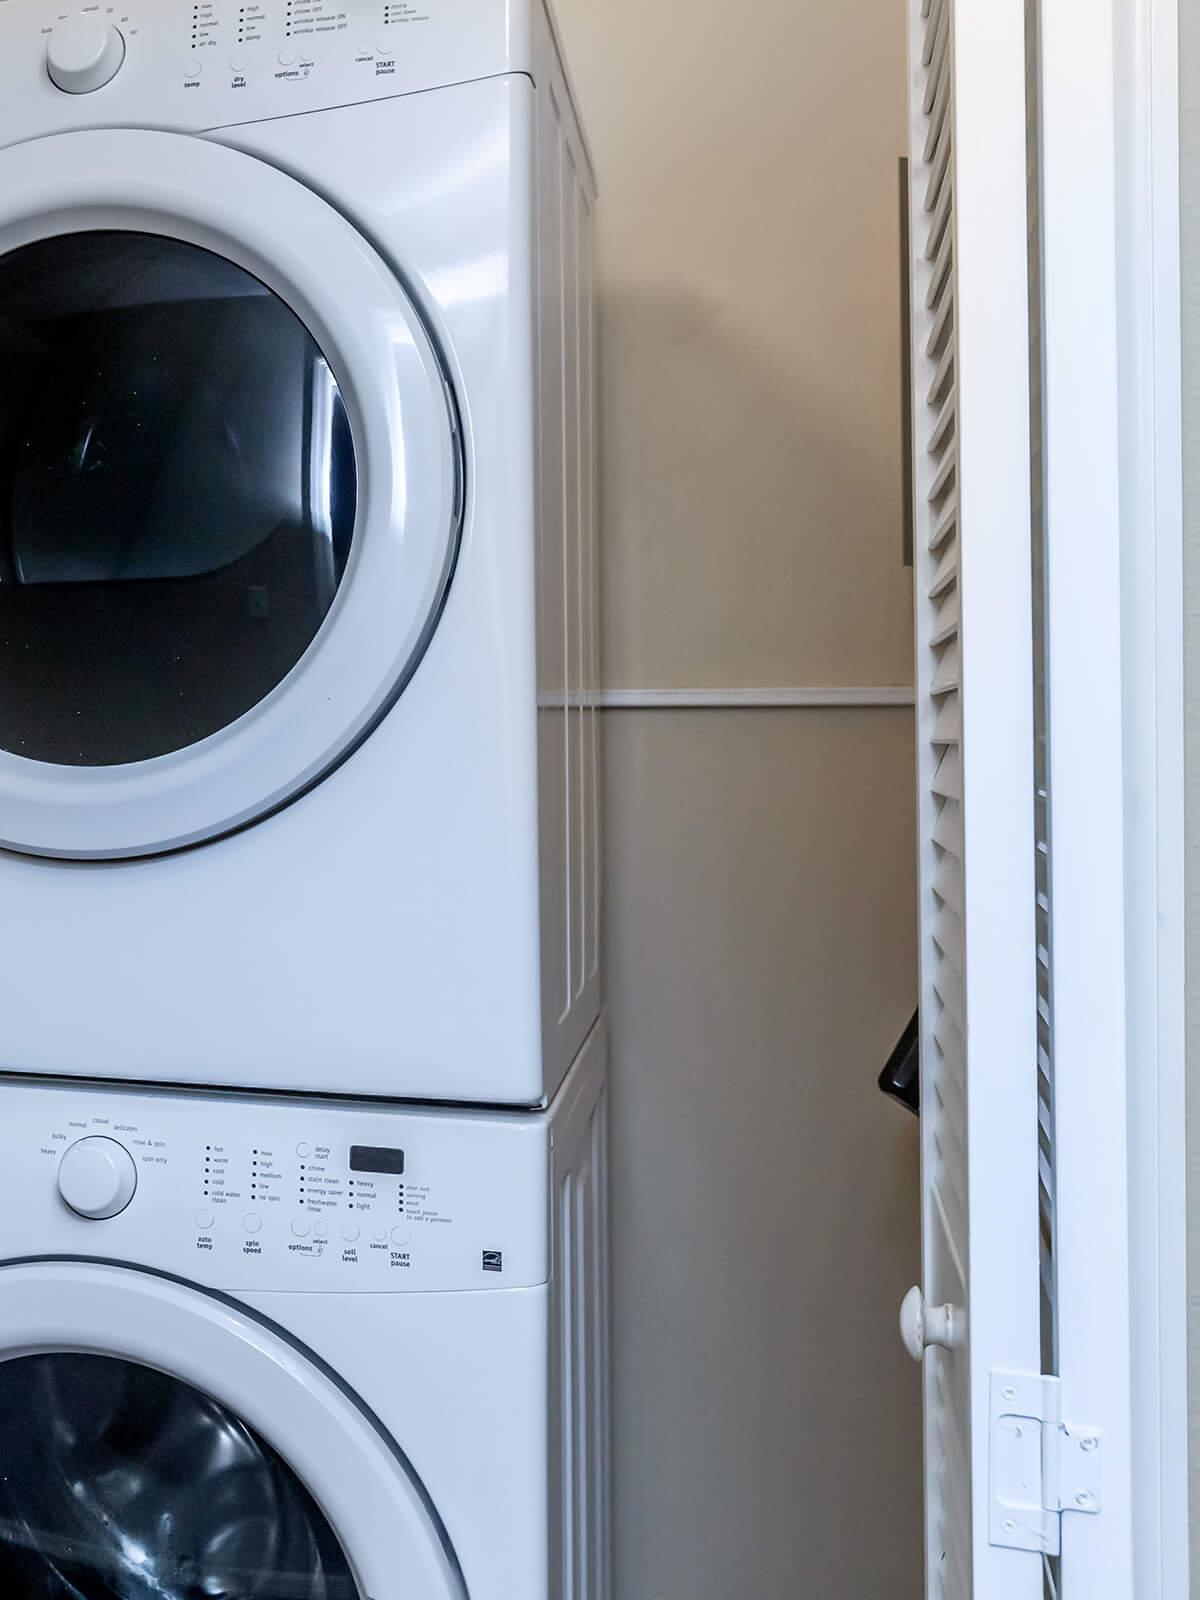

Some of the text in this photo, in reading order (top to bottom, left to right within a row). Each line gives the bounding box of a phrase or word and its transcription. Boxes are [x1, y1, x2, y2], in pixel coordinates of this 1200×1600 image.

[288, 1244, 312, 1252] options
[342, 1255, 358, 1263] level
[390, 1252, 410, 1260] START
[390, 1260, 410, 1268] pause
